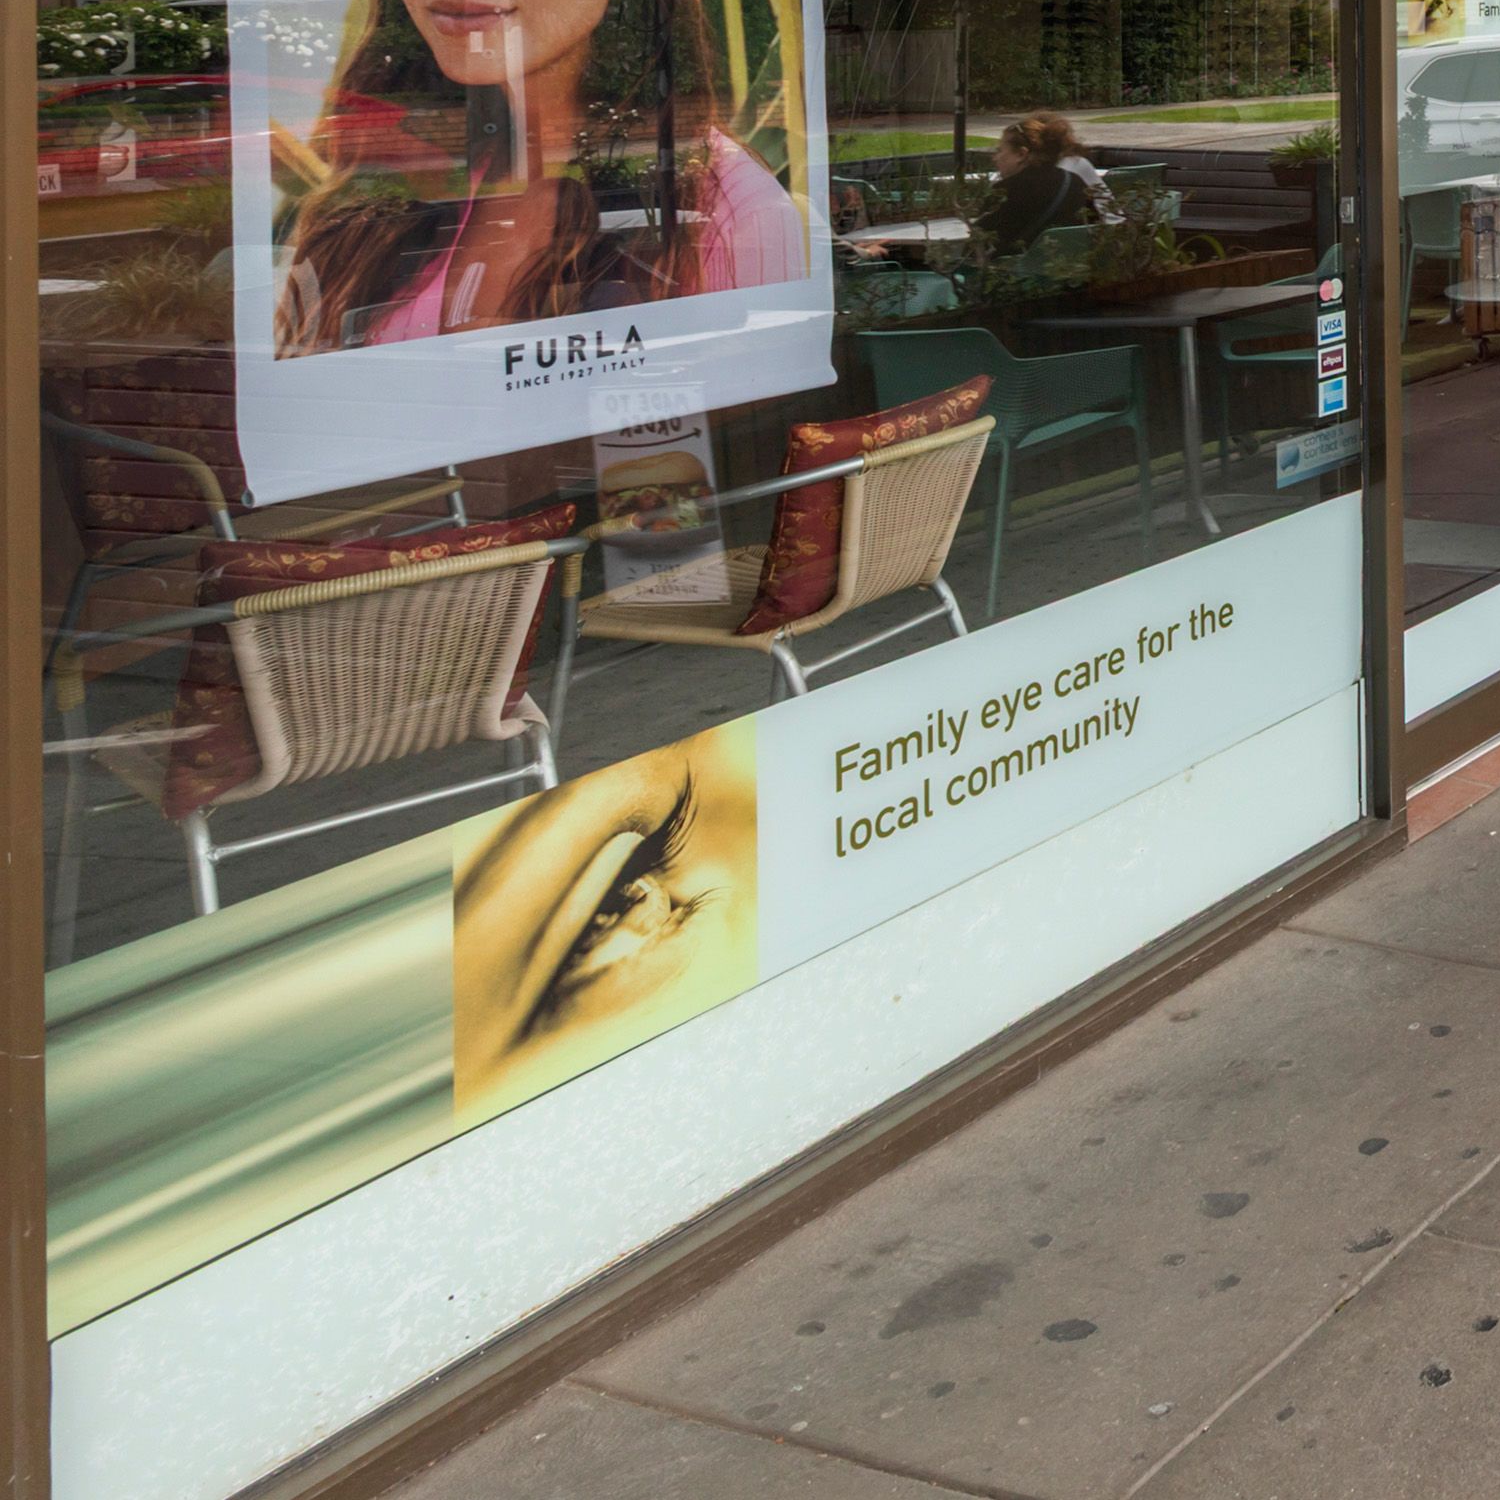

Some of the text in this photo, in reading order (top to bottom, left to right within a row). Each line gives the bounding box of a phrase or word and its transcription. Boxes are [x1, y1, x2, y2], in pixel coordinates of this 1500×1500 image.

[504, 324, 646, 376] FURLA
[1323, 318, 1342, 332] VISA
[505, 356, 646, 392] SINCE 1927 ITALY
[834, 599, 1235, 792] Family eye care for the
[834, 695, 1141, 858] local community
